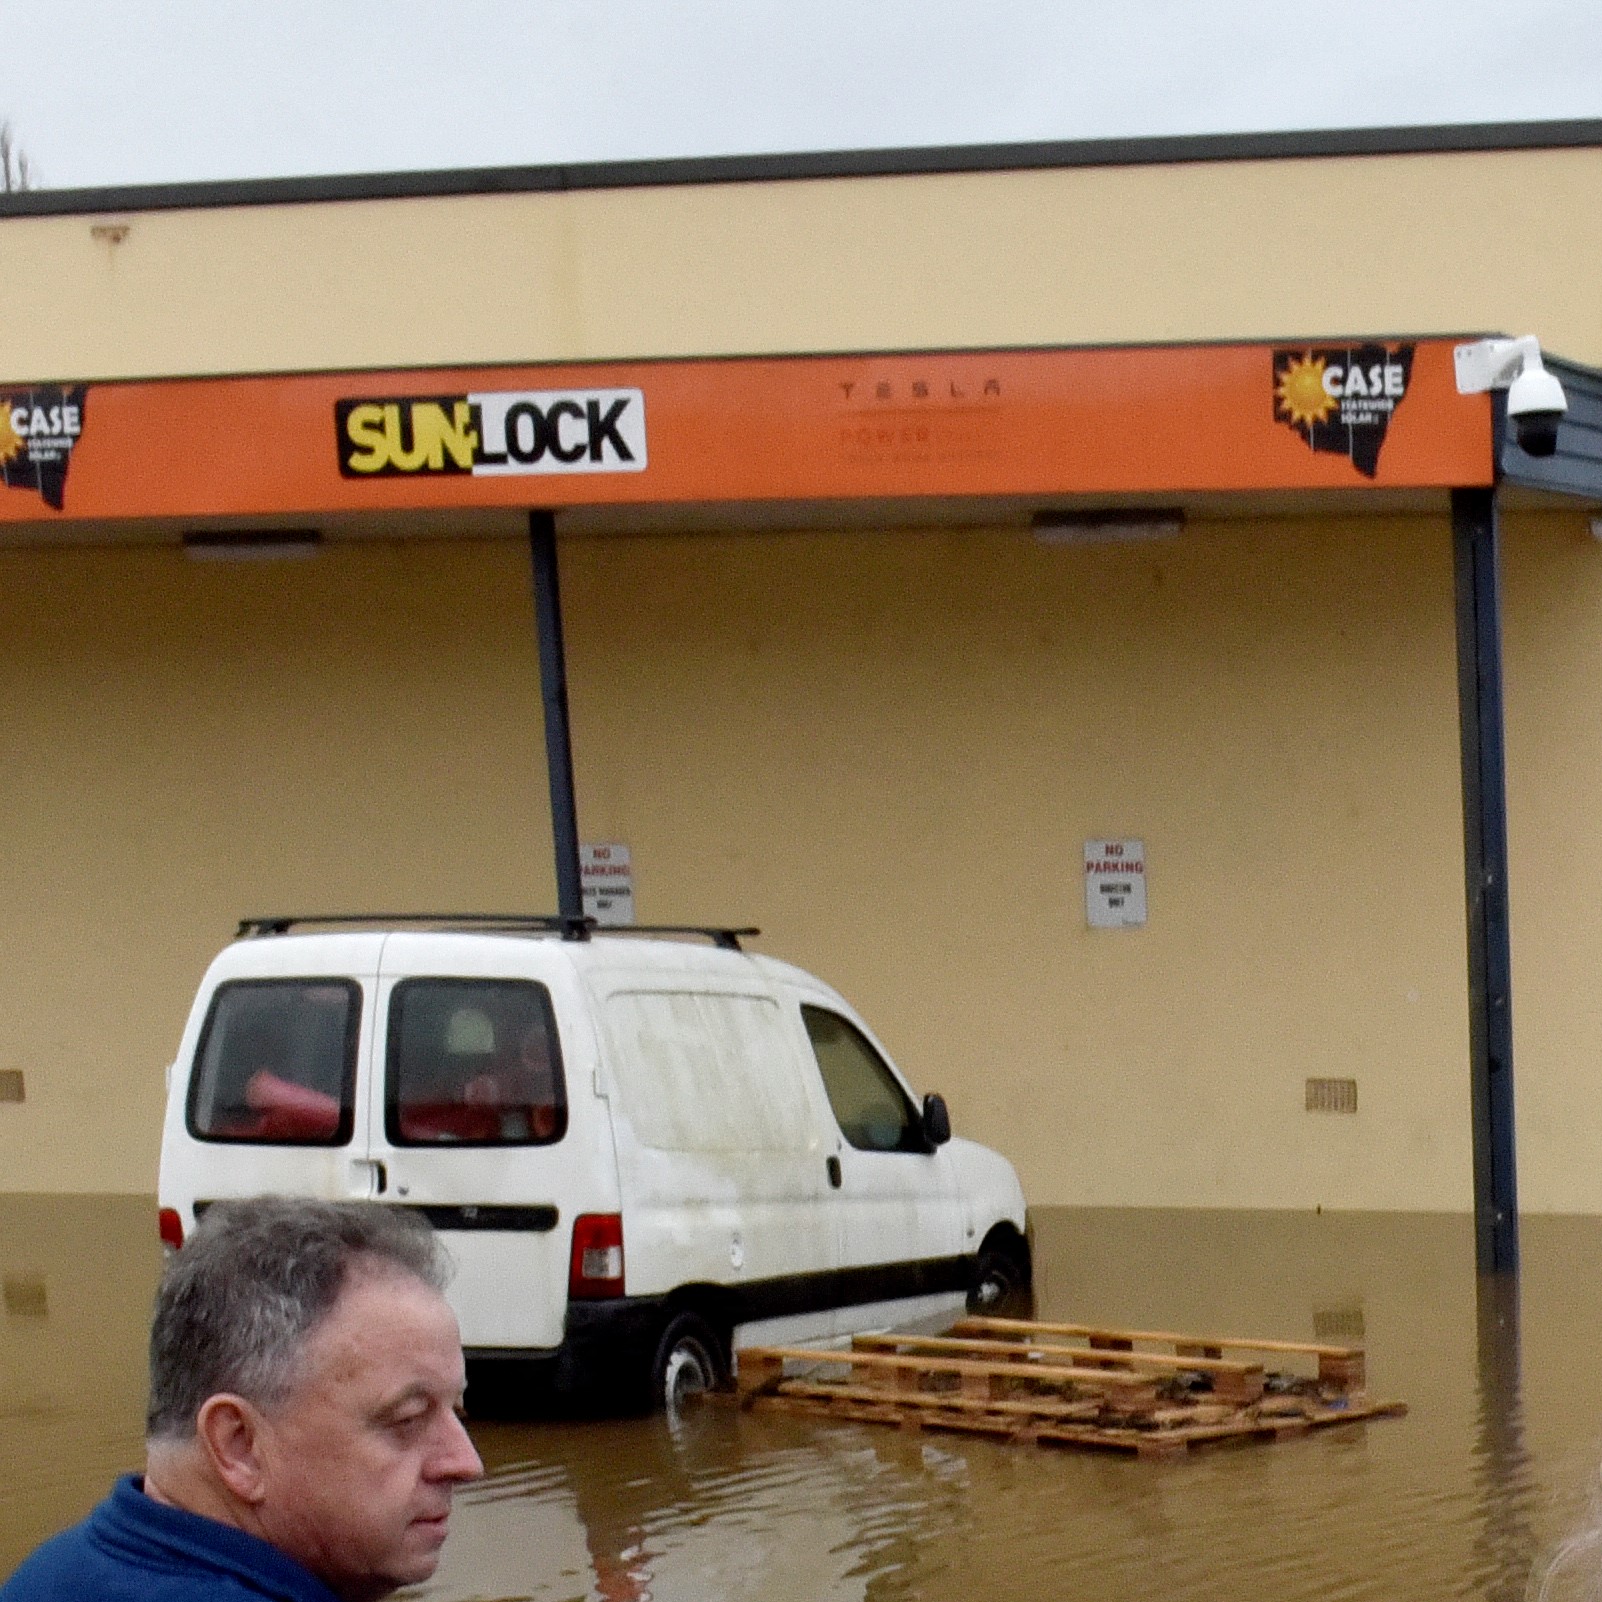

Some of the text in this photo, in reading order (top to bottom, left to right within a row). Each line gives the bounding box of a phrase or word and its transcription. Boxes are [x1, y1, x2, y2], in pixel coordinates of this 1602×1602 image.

[1322, 364, 1404, 397] CASE
[10, 405, 81, 436] CASE
[1105, 844, 1124, 856] NO
[583, 865, 630, 876] ARKING
[1086, 861, 1144, 874] PARKING
